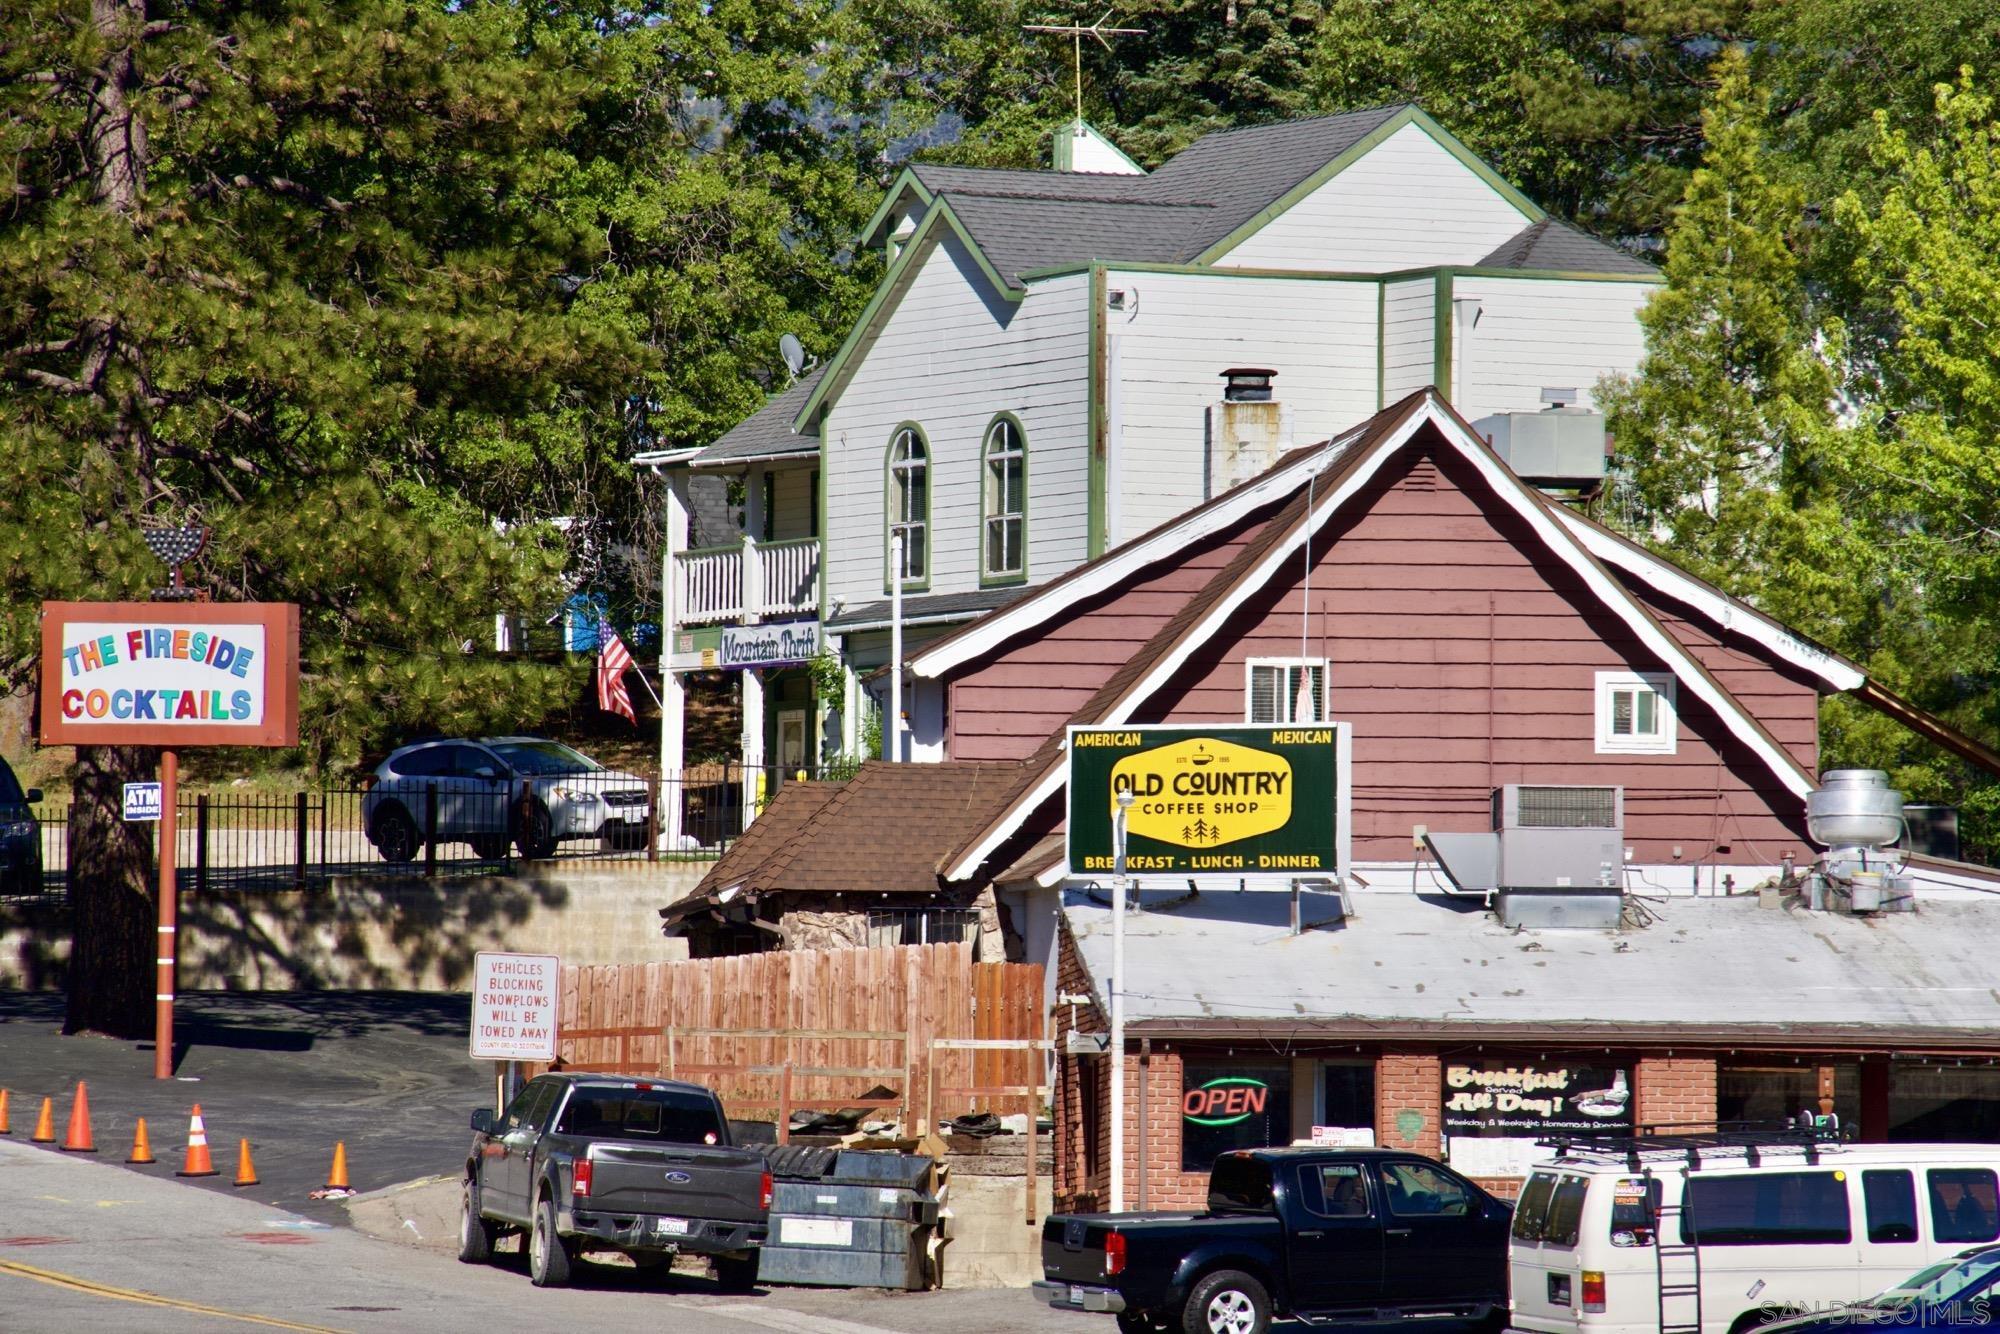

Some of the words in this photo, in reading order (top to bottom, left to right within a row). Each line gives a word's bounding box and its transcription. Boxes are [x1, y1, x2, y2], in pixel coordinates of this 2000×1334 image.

[723, 632, 779, 663] Mountain
[781, 626, 815, 658] Thrift
[63, 634, 119, 677] THE
[126, 627, 254, 679] FIRESIDE
[62, 688, 252, 720] COCKTAILS
[1074, 732, 1142, 747] AMERICAN
[1271, 730, 1332, 745] MEXICAN
[1113, 773, 1164, 797] OLD
[1173, 771, 1288, 796] COUNTRY
[126, 789, 159, 806] ATM
[126, 806, 159, 814] INSIDE
[1142, 802, 1205, 815] COFFEE
[1214, 801, 1259, 814] SHOP
[1085, 855, 1175, 869] BREKFAST
[1192, 855, 1243, 868] LUNCH
[1259, 854, 1320, 868] DINNER
[491, 962, 543, 975] VEHICLES
[490, 977, 543, 991] BLOCKING
[482, 993, 549, 1008] SNOWPLOWS
[492, 1009, 517, 1022] WILL
[524, 1011, 538, 1023] BE
[480, 1025, 515, 1038] TOWED
[520, 1027, 548, 1039] AWAY
[1447, 1066, 1569, 1093] Breakfast
[1183, 1088, 1267, 1115] OPEN
[1445, 1092, 1493, 1112] All
[1495, 1093, 1564, 1117] Day!
[1446, 1118, 1486, 1128] Weekday
[1497, 1118, 1540, 1128] Weeknight
[1542, 1120, 1591, 1129] Homemade
